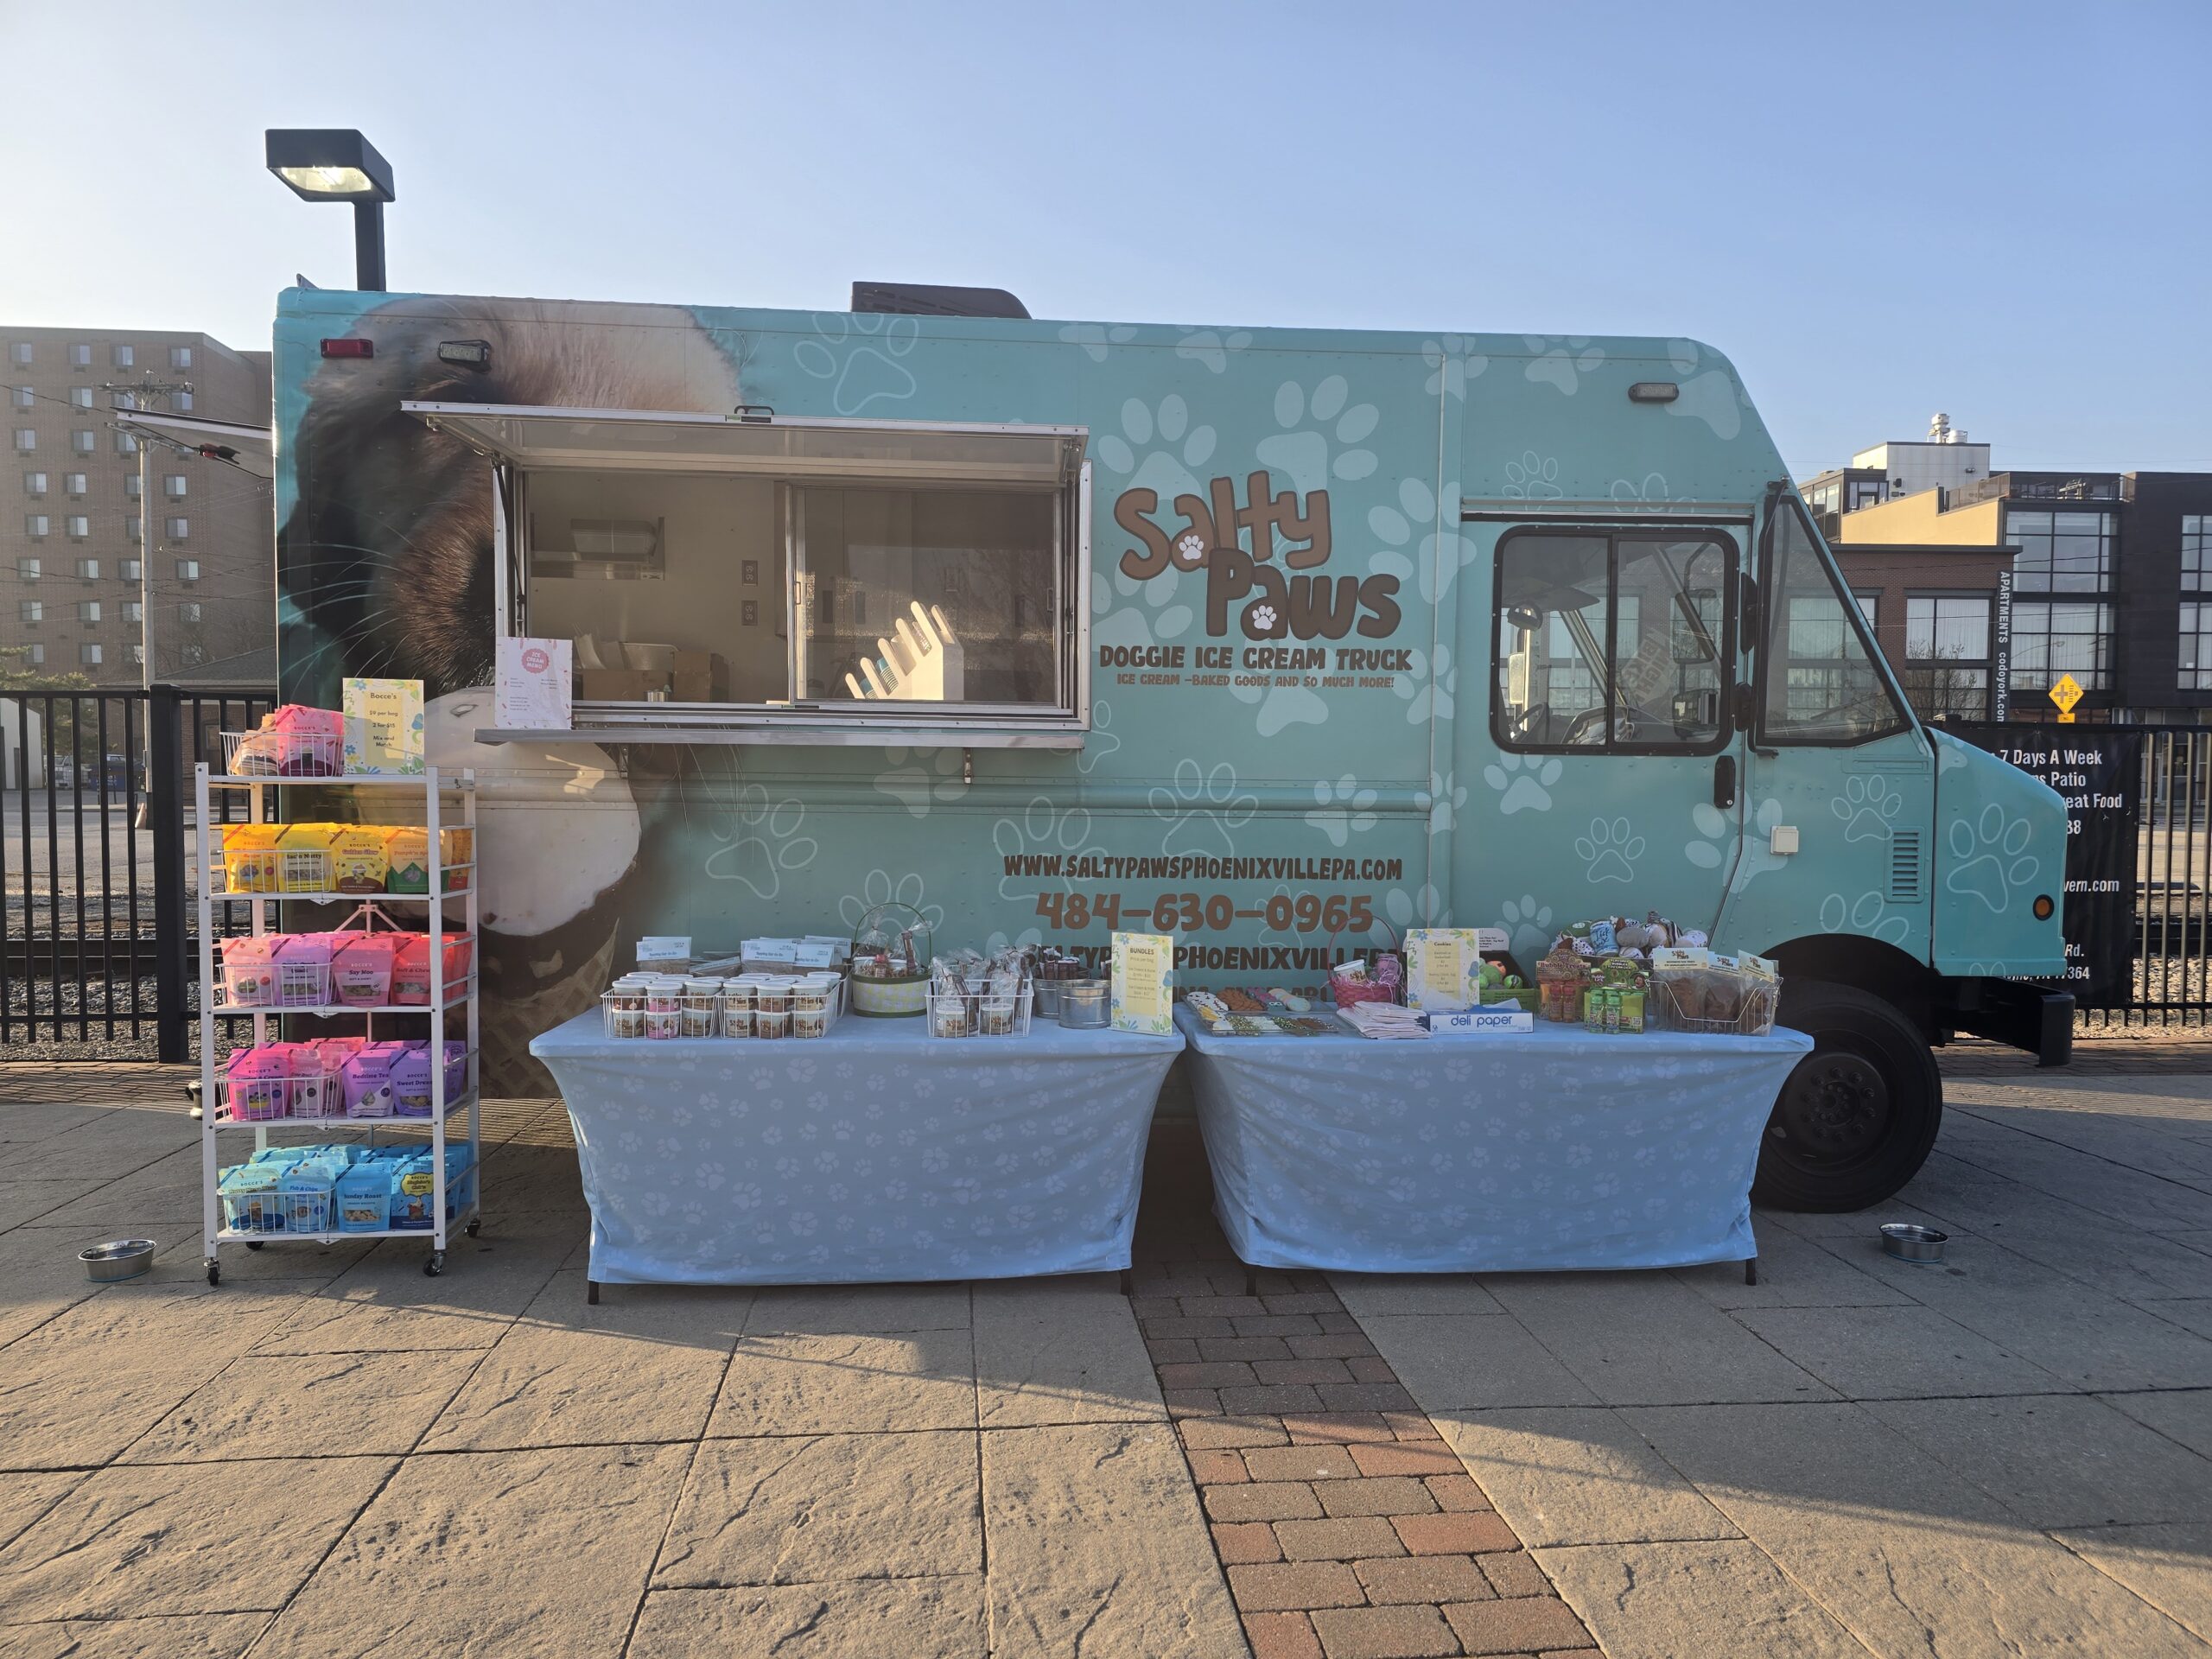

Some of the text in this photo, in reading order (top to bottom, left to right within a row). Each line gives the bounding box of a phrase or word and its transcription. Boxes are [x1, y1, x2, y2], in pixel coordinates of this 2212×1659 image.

[1114, 470, 1332, 581] Salty
[1206, 548, 1402, 640] Paws
[1999, 571, 2011, 644] APARTMENTS
[1099, 645, 1413, 671] DOGGIE ICE CREAM TRUCK
[1116, 673, 1135, 684] ICE
[1140, 673, 1180, 685] CREAM
[1234, 675, 1271, 687] GOODS
[1274, 675, 1299, 687] AND
[1303, 676, 1318, 687] SO
[1323, 676, 1355, 687] MUCH
[1358, 676, 1395, 688] MORE!
[2013, 749, 2046, 767] Days
[2050, 749, 2060, 765] A
[2064, 749, 2102, 765] Week
[2050, 772, 2086, 786] Patio
[2093, 793, 2122, 809] Food
[1003, 855, 1402, 880] WWW.SALTYPAWSPHOENIXVILLEPA.COM
[1035, 893, 1372, 931] 484-630-0965
[2064, 944, 2084, 957] Rd.
[1451, 1015, 1512, 1027] deli paper
